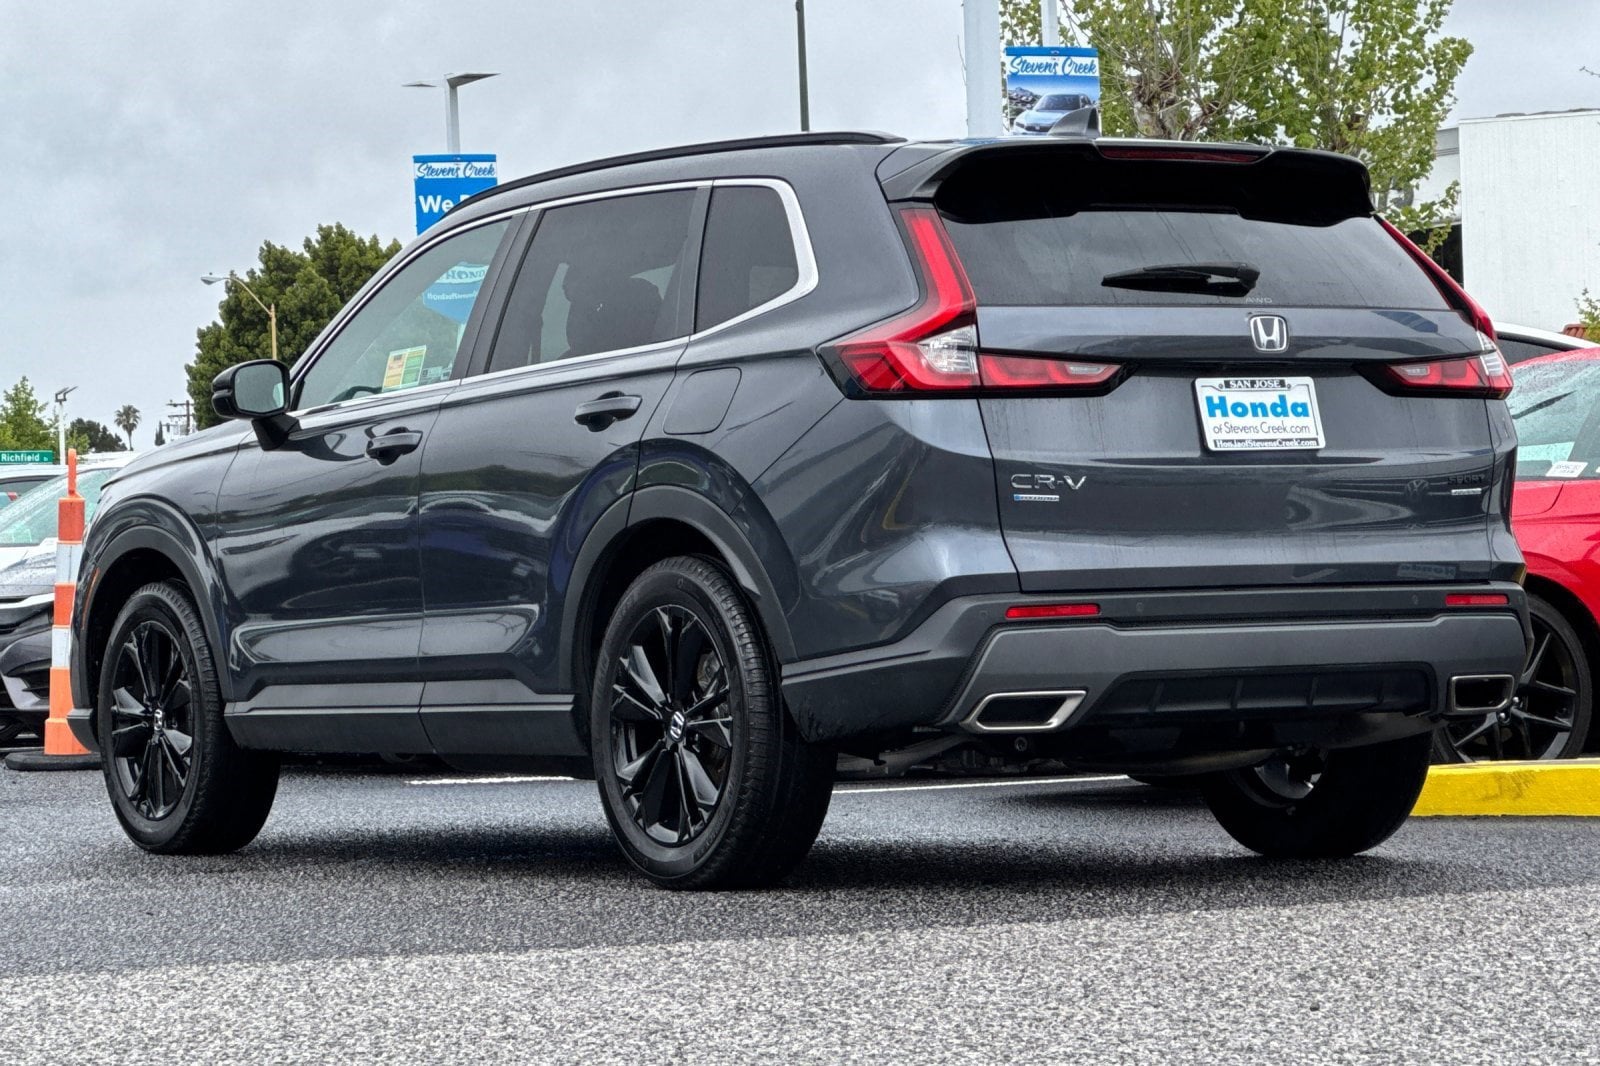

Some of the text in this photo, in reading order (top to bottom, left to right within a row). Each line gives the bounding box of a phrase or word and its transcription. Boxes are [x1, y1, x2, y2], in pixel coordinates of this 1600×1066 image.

[1009, 56, 1097, 76] Stevens Creek
[417, 162, 495, 179] Stevens Creek
[418, 195, 455, 214] We
[1229, 380, 1281, 389] SAN JOSE
[1205, 394, 1310, 418] Honda
[1213, 424, 1223, 434] of
[1, 453, 40, 462] Richfield
[1010, 474, 1087, 490] CR-V
